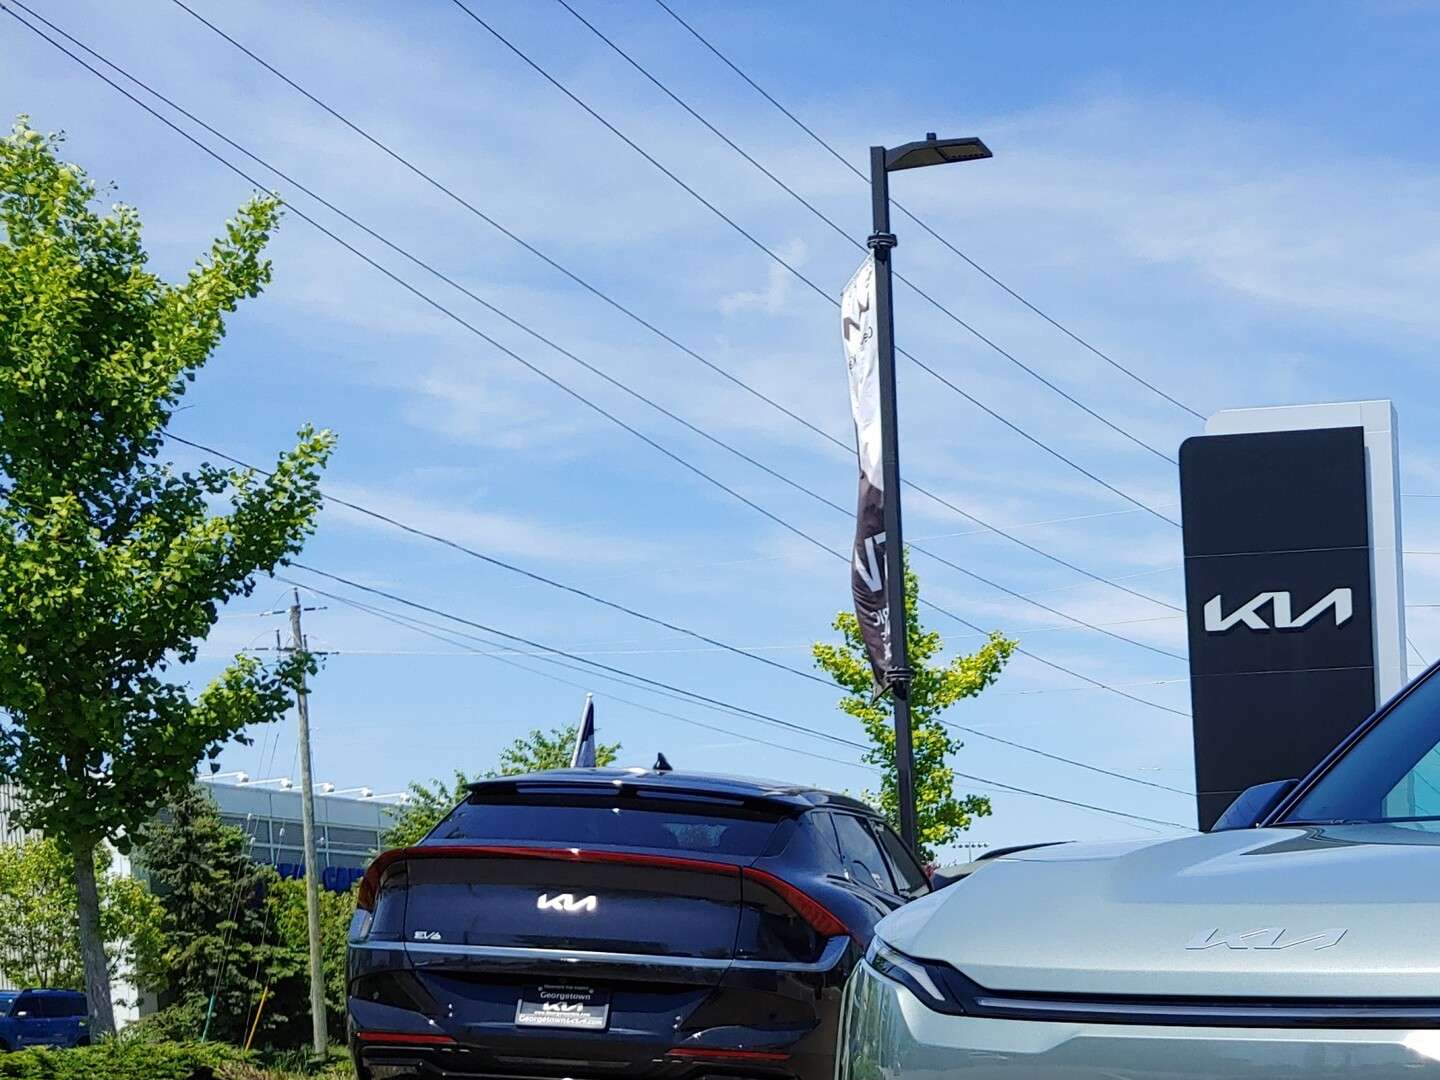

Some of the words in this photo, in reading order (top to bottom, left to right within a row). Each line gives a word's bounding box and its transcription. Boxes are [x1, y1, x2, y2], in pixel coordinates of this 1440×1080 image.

[1203, 587, 1353, 632] KIA
[537, 893, 597, 912] KIA
[1185, 928, 1348, 951] KIA
